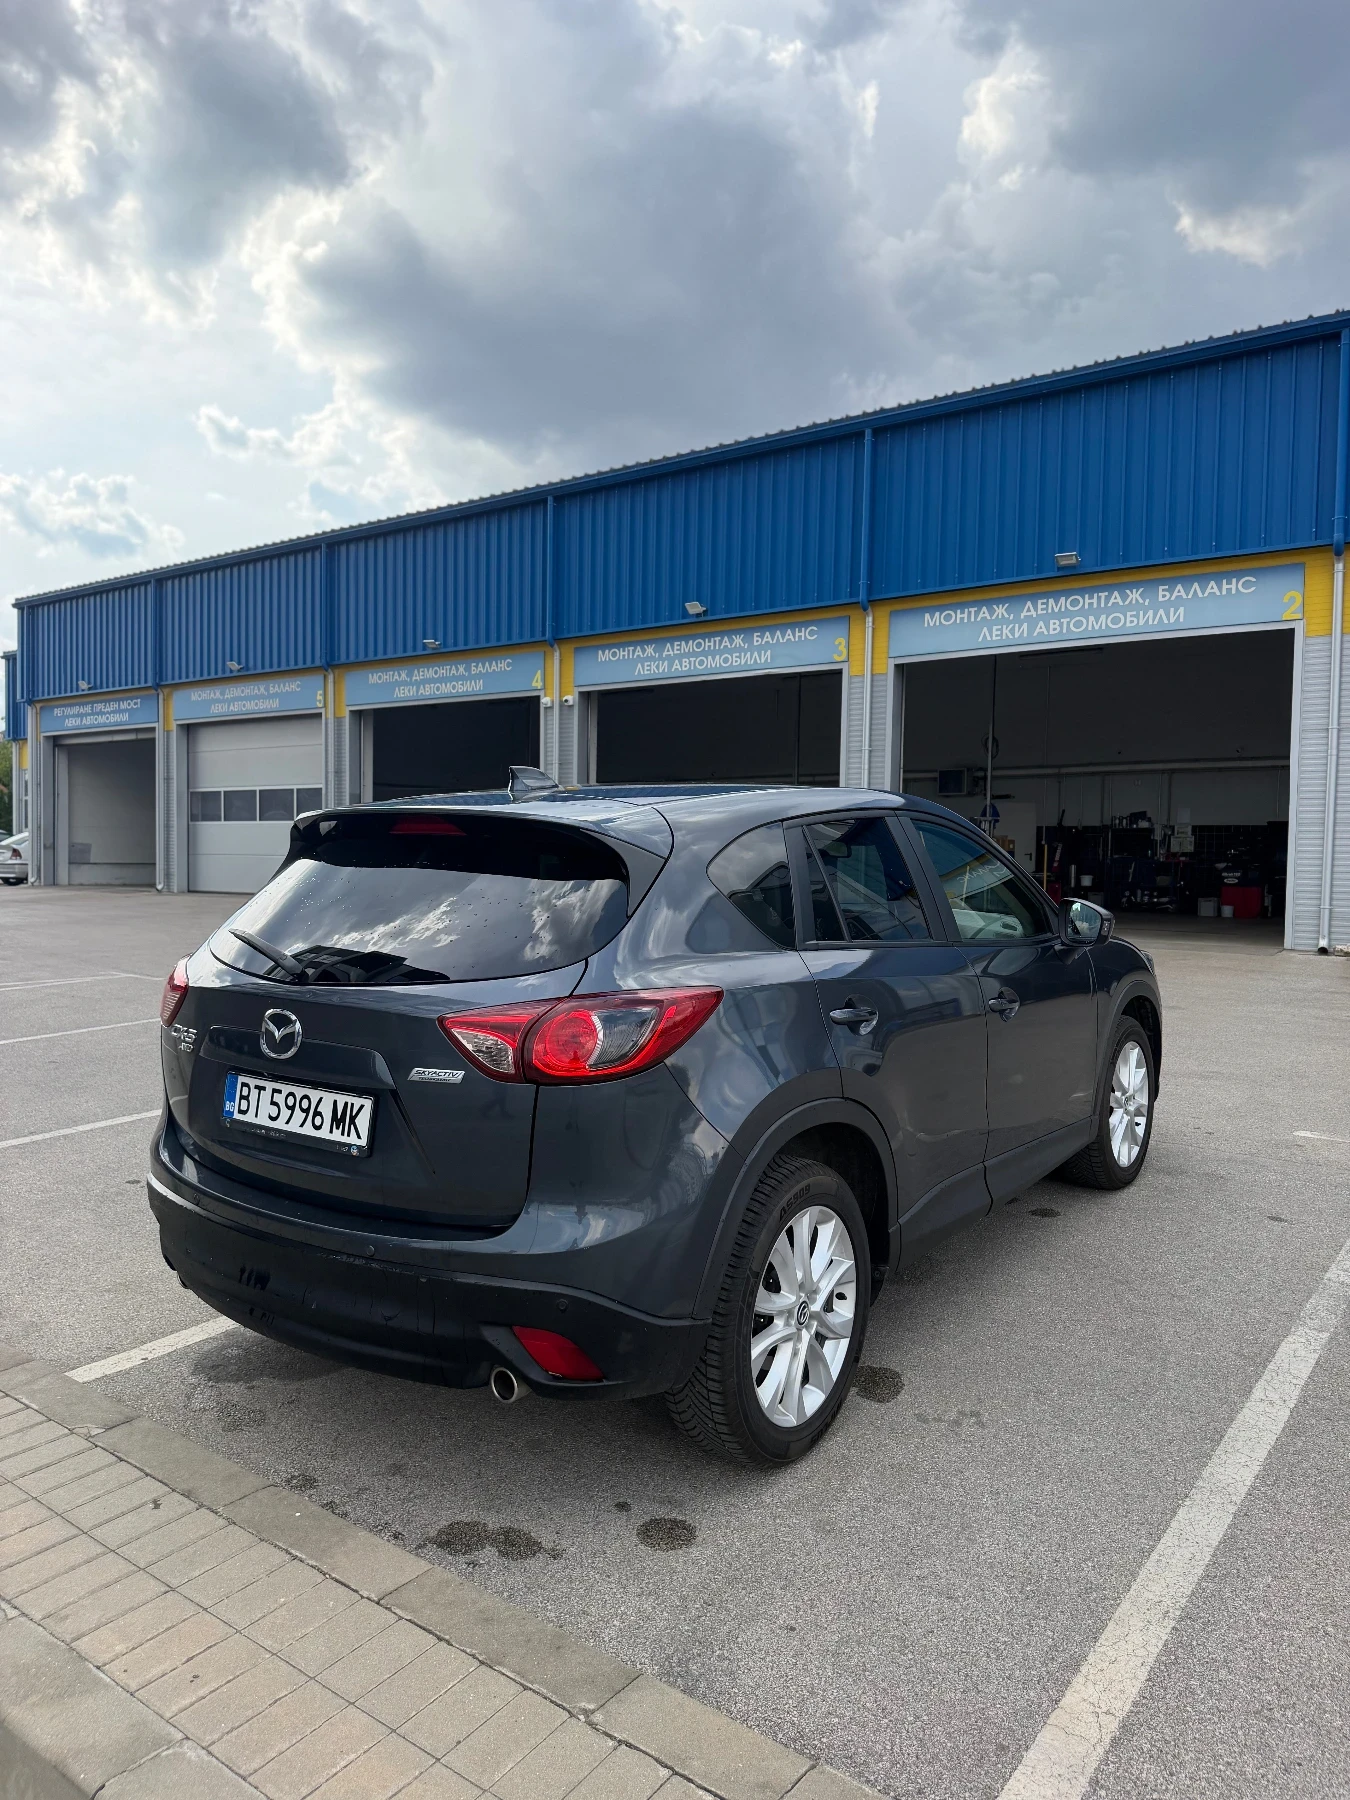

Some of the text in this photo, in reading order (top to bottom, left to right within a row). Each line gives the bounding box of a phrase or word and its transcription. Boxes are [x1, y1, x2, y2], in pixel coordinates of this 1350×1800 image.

[923, 576, 1257, 627] МОНТАЖ, ДЕМОНТАЖ, БАЛАНС
[1281, 590, 1303, 621] 2
[977, 607, 1185, 642] ЛЕКИ АВТОМОБИЛИ
[598, 626, 818, 662] МОНТАЖ, ДЕМОНТАЖ, БАЛАНС
[833, 637, 847, 662] 3
[368, 659, 513, 685] МОНТАЖ, ДЕМОНТАЖ, БАЛАНС
[634, 650, 771, 676] ЛЕКИ АВТОМОБИЛИ
[394, 679, 483, 698] ЛЕКИ АВТОМОБИЛИ
[531, 670, 543, 689] 4
[191, 681, 301, 701] МОНТАЖ, ДЕМОНТАЖ, БАЛАНС
[316, 690, 323, 708] 5
[53, 698, 141, 717] РЕГУЛИРАНЕ ПРЕДЕН МОСТ
[210, 698, 279, 714] ЛЕКИ АВТОМОБИЛИ
[64, 713, 129, 727] ЛЕКИ АВТОМОБИЛИ
[414, 1069, 459, 1078] SKYACTIV
[225, 1100, 235, 1112] BG
